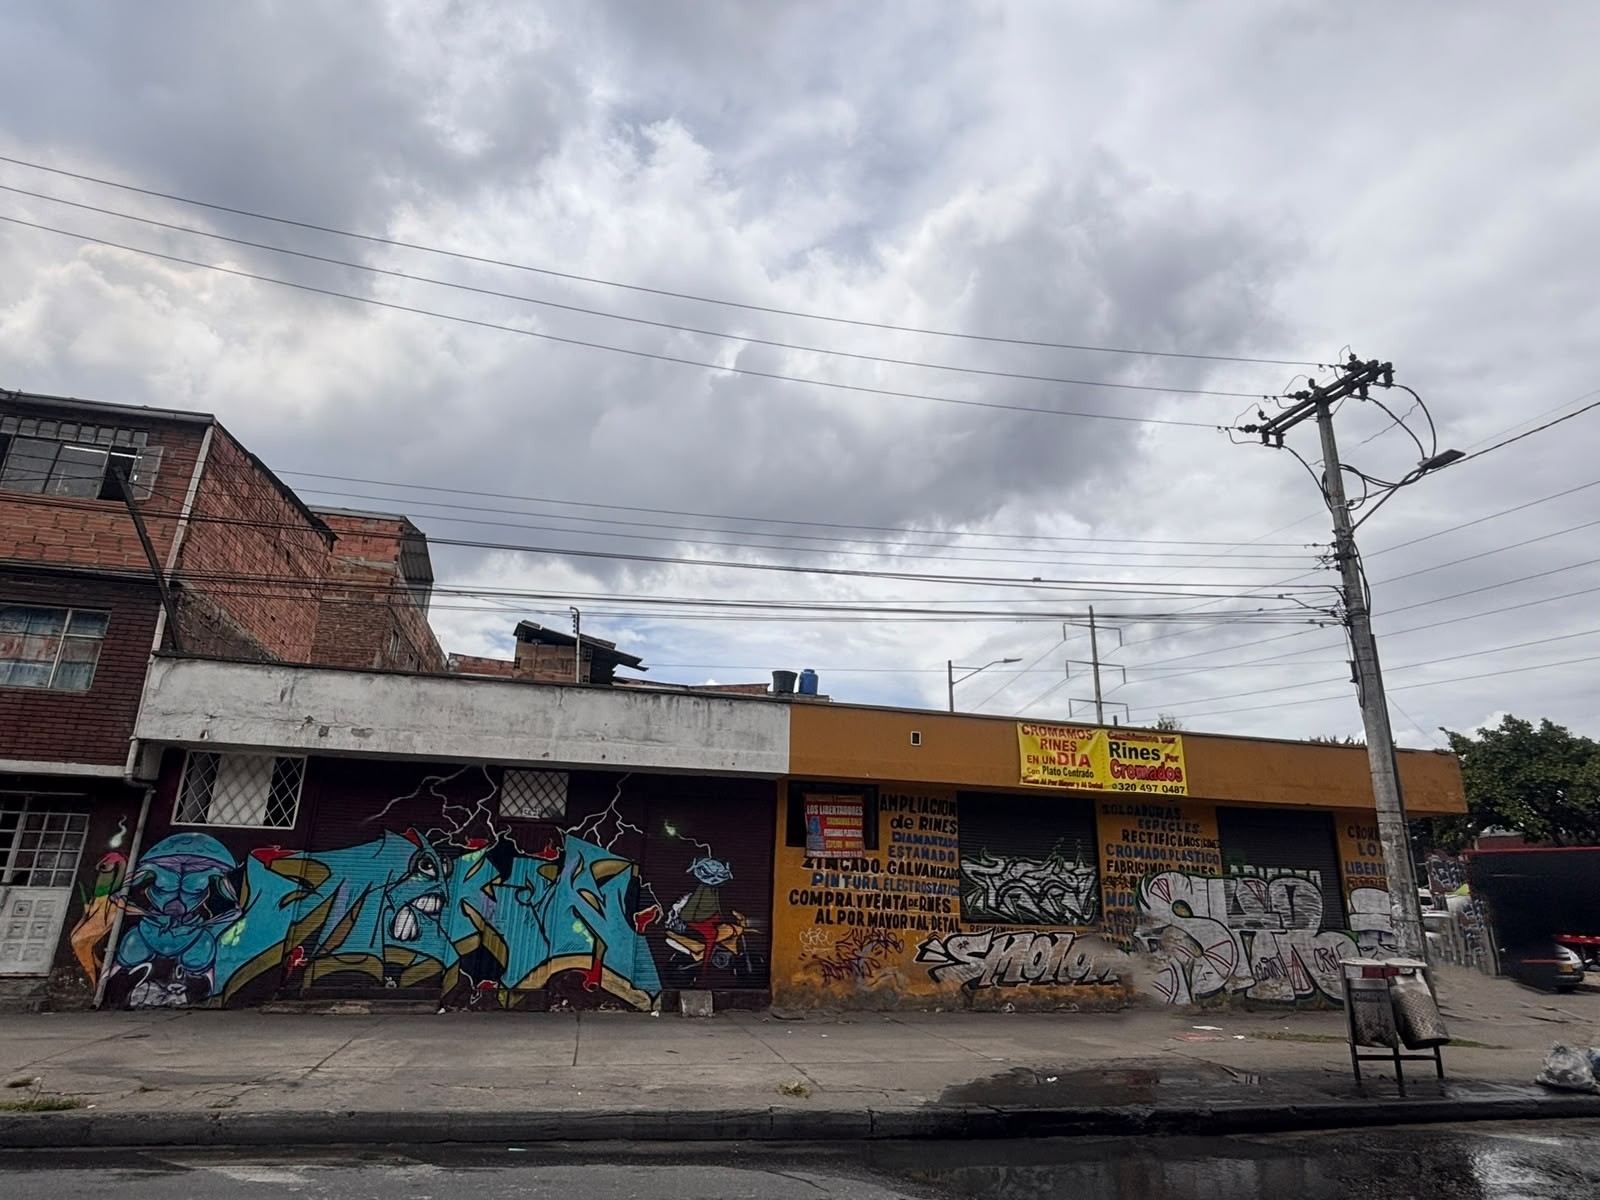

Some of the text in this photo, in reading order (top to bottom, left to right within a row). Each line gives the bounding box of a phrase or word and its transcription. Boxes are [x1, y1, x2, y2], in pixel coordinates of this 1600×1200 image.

[1021, 724, 1093, 741] CROMAMOS
[1040, 738, 1077, 753] RINES
[1108, 741, 1161, 761] Rines
[1027, 755, 1039, 764] EN
[1042, 756, 1056, 766] UN
[1042, 766, 1062, 777] Plato
[1063, 767, 1094, 779] Centrado
[1110, 758, 1183, 783] Cromados
[1118, 783, 1185, 794] 320 497 0487
[807, 804, 819, 816] LOS
[890, 814, 957, 835] de RINES
[1122, 829, 1201, 848] RECTIFICAMOS
[1106, 844, 1167, 861] CROMADO
[1107, 861, 1171, 874] FABRICAMOS
[865, 895, 908, 912] VENTA
[815, 909, 834, 925] AL
[837, 910, 864, 926] POR
[868, 912, 907, 930] MAYOR
[931, 917, 962, 933] DETAL
